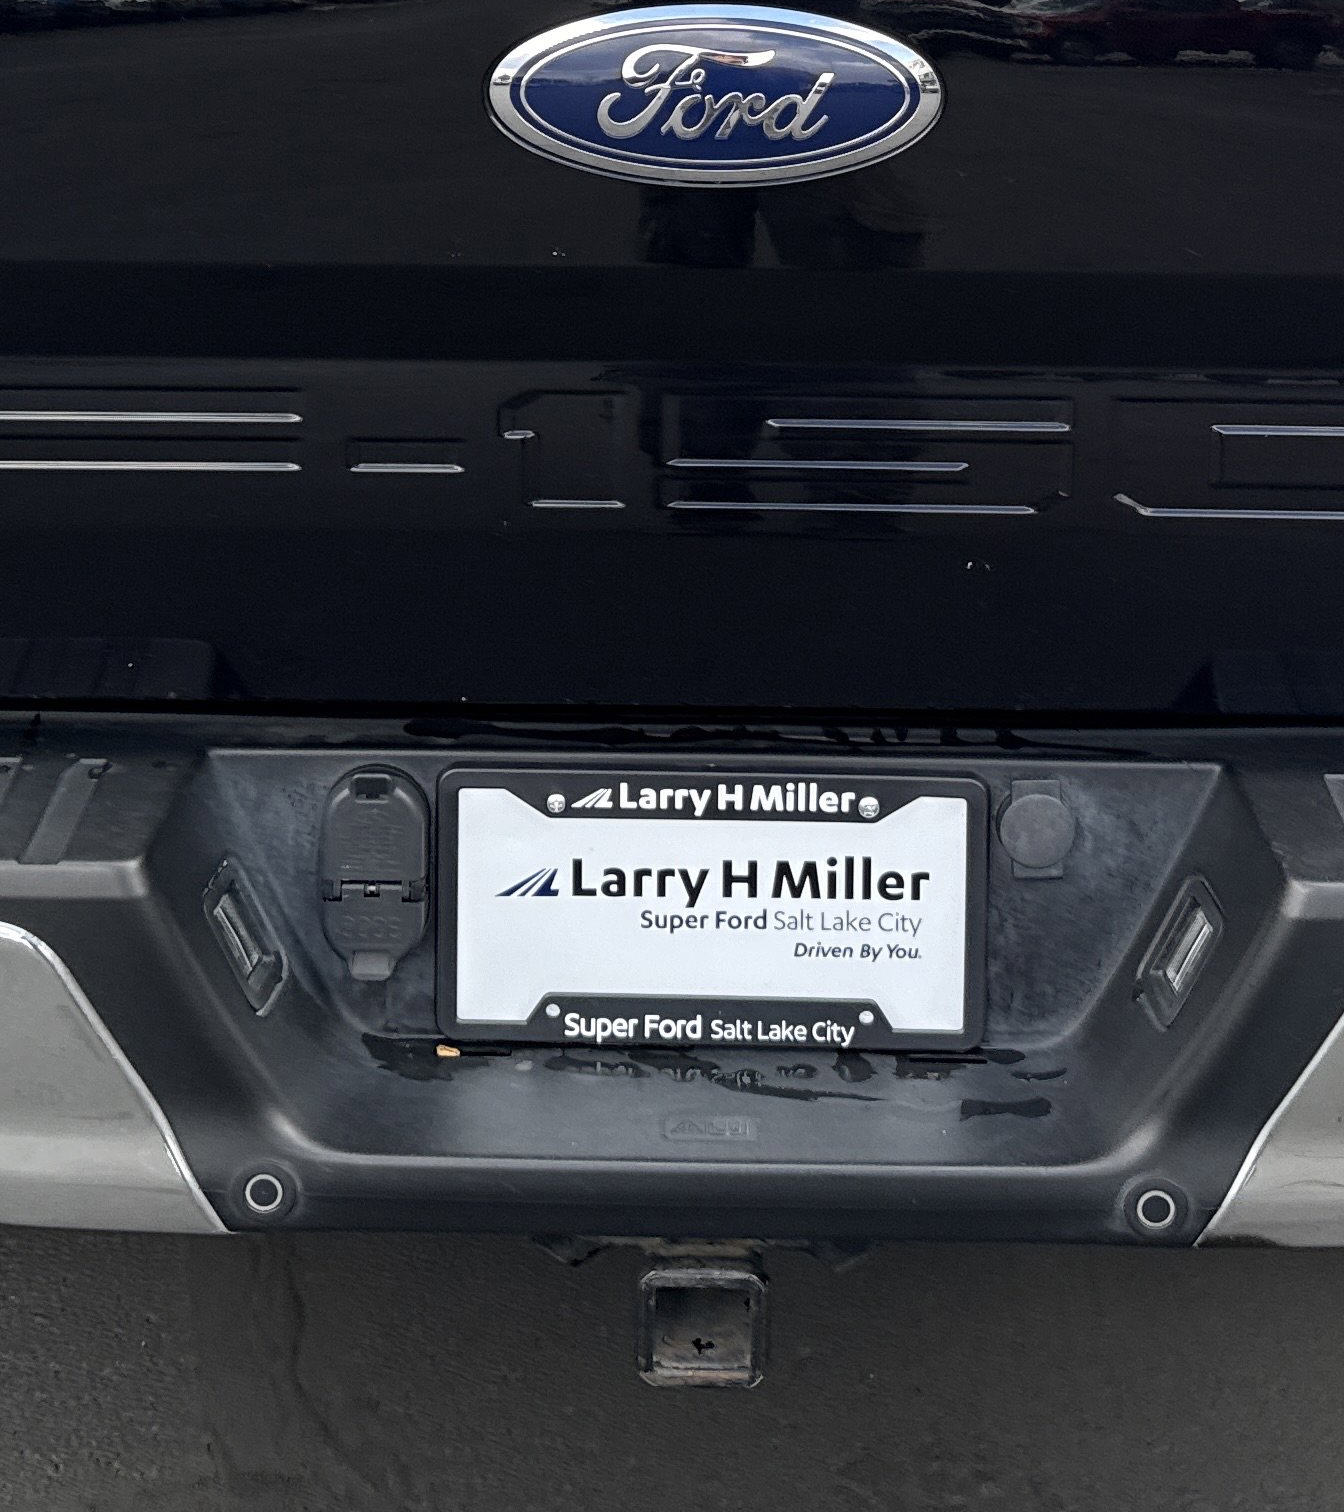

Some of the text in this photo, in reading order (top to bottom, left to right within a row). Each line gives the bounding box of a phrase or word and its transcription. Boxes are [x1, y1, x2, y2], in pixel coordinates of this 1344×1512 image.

[596, 42, 837, 142] Ford
[618, 781, 857, 817] Larry H Miller
[571, 855, 931, 908] Larry H Miller
[639, 908, 923, 938] Super Ford Salt Lake City
[793, 941, 854, 958] Driven
[859, 943, 883, 963] By
[563, 1011, 856, 1048] Super Ford Salt Lake City
